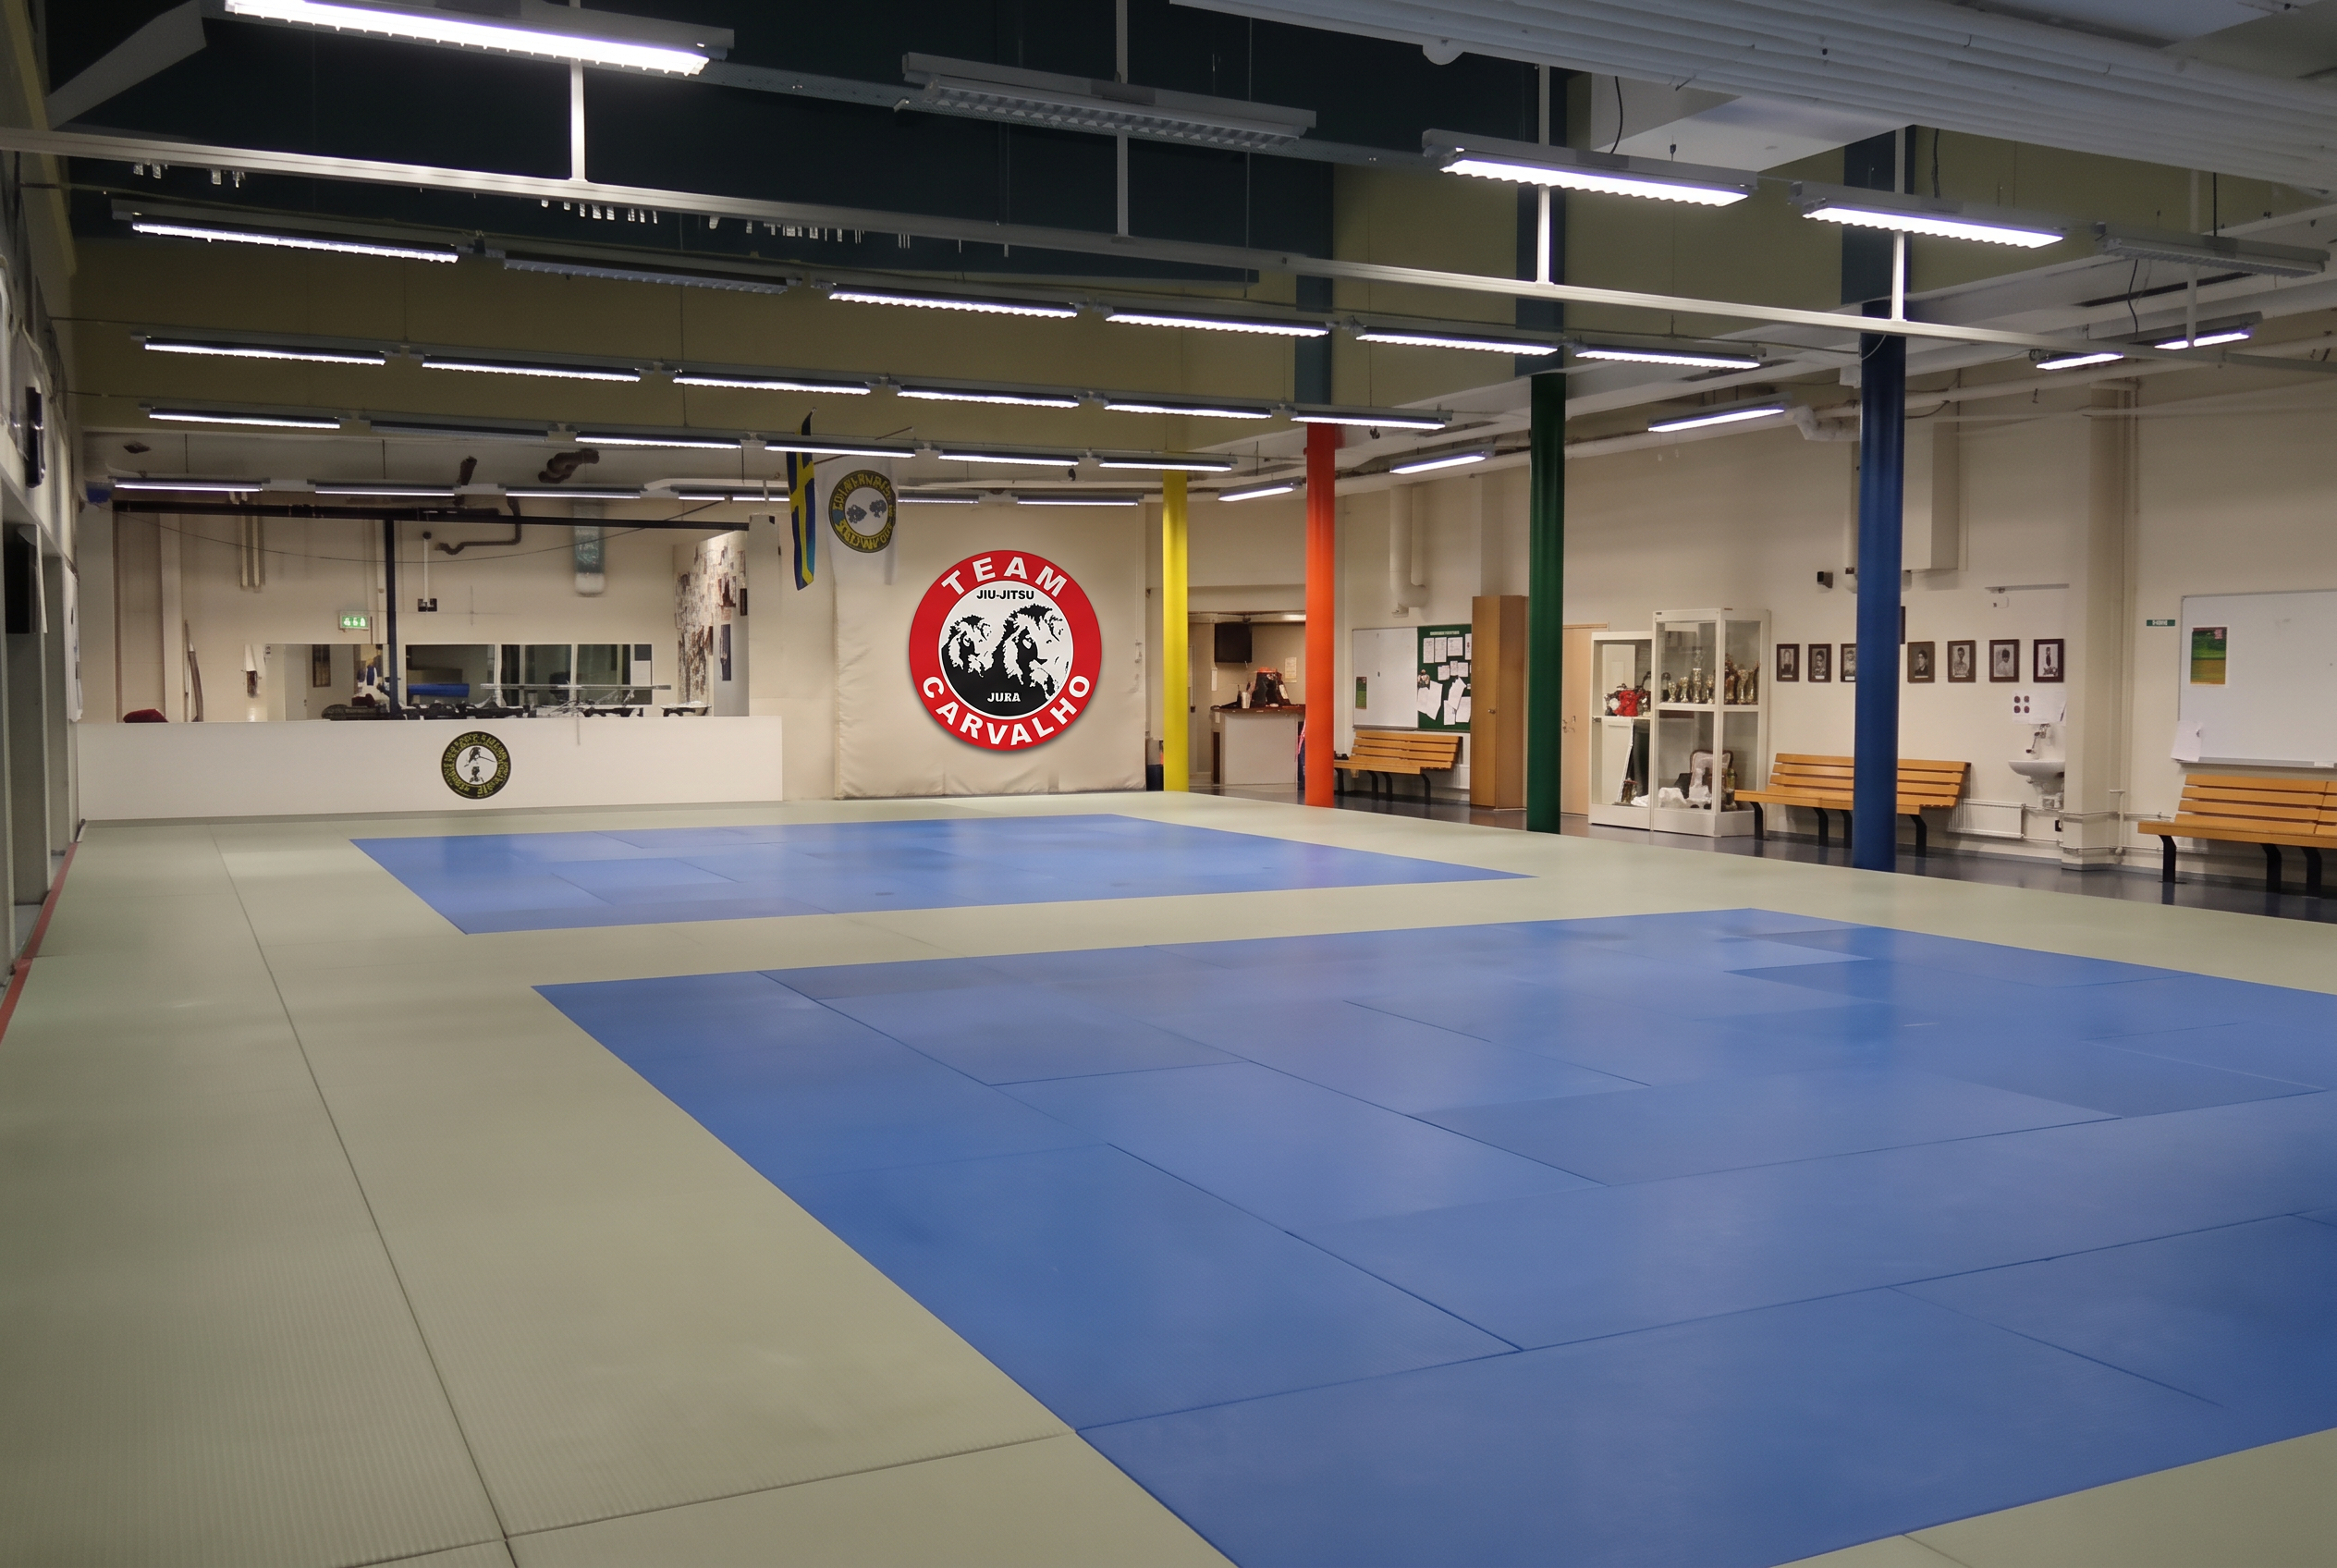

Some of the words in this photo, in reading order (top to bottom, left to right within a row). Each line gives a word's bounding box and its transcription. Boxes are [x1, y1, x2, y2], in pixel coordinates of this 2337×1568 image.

[941, 556, 1068, 597] TEAM
[976, 589, 1034, 600] JIU-JITSU
[923, 675, 1091, 746] CARVALHO
[986, 692, 1022, 703] JURA
